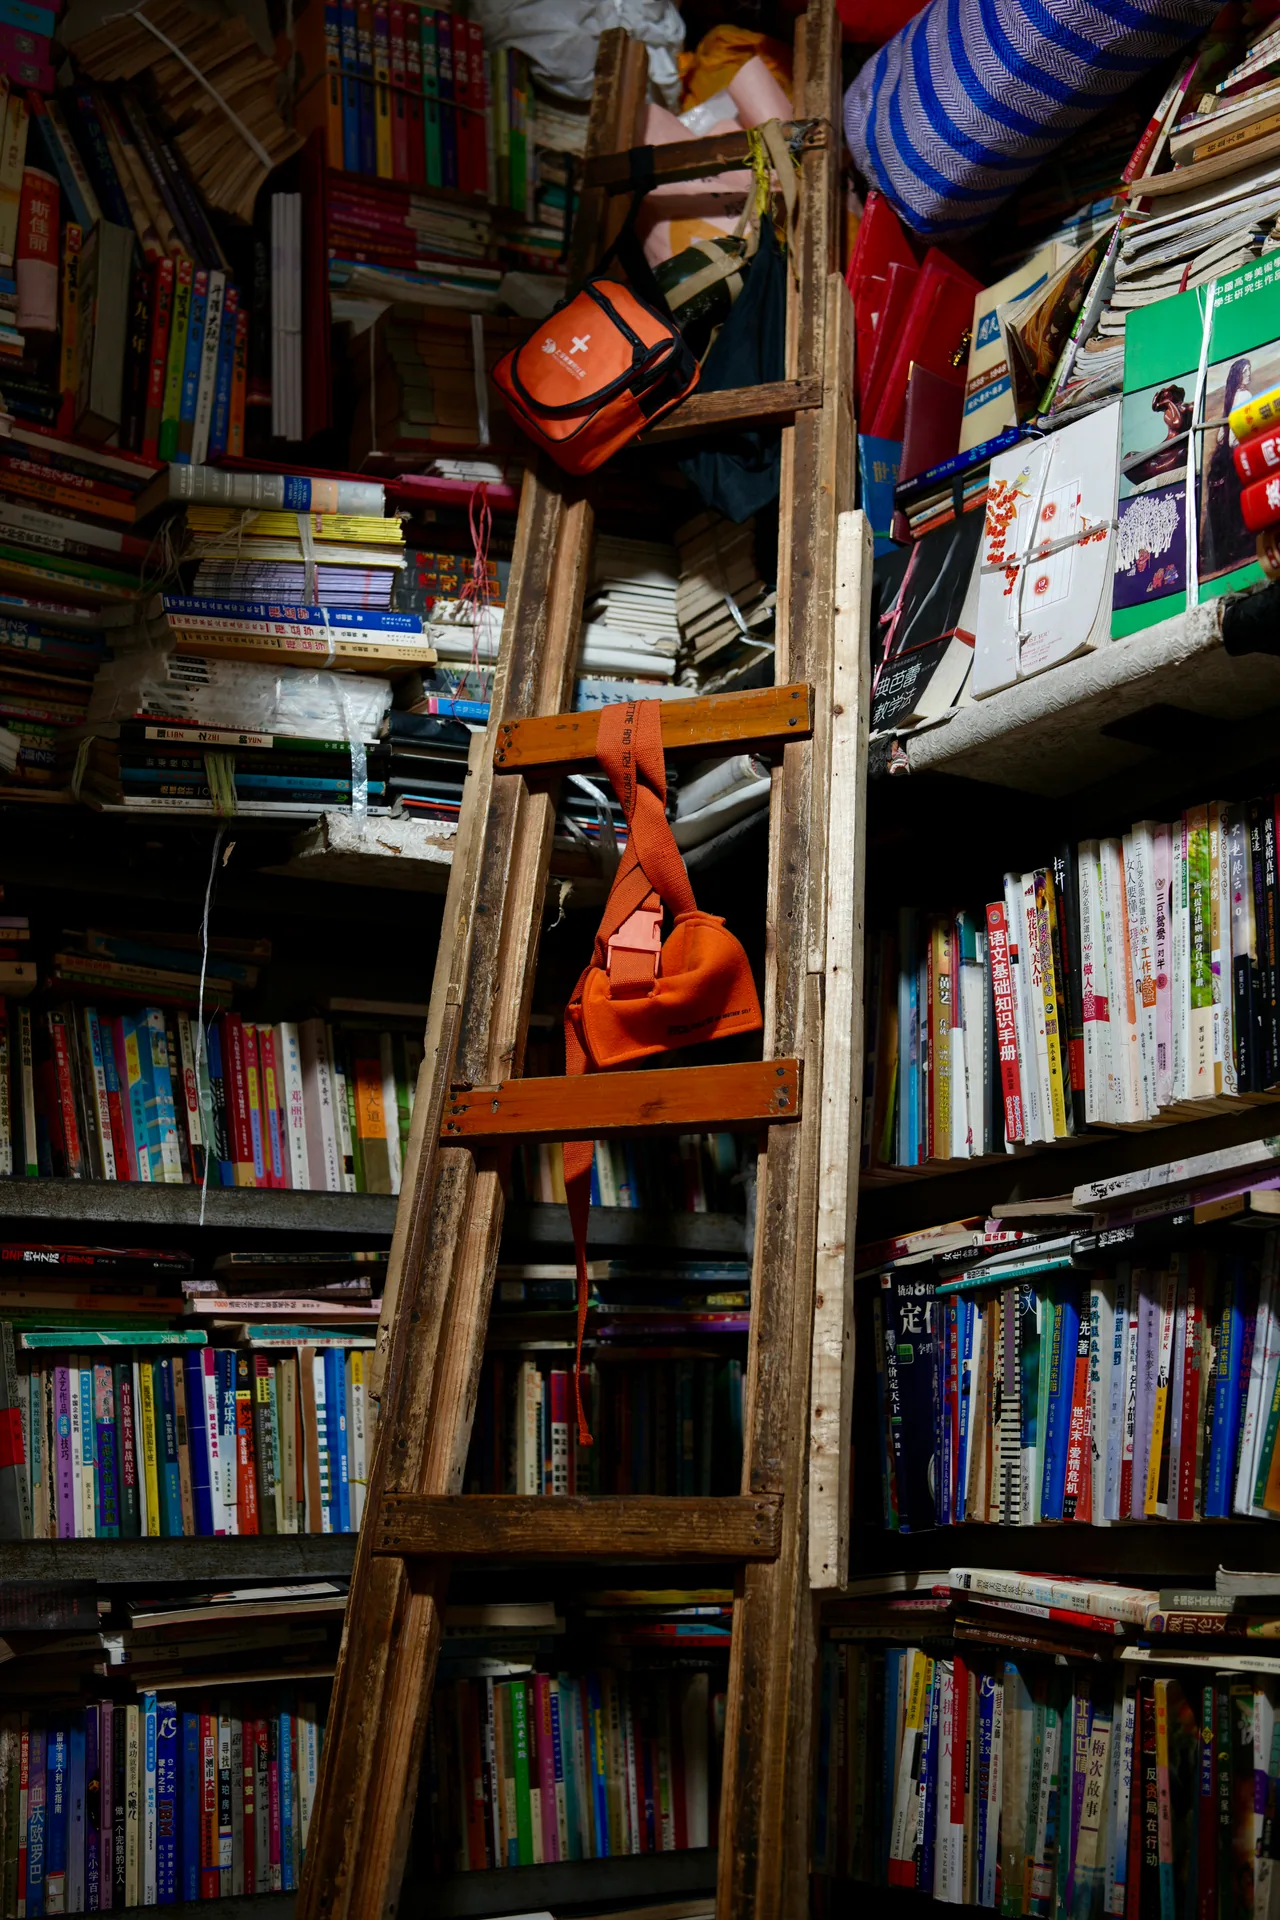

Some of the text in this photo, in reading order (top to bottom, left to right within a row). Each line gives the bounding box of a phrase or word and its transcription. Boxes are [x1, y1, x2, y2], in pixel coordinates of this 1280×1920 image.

[26, 199, 49, 254] 斯佳丽
[621, 727, 632, 746] AND
[621, 748, 632, 769] TRY
[1126, 858, 1141, 957] 女人要懂心理学
[988, 929, 1017, 1062] 语文基础知识手册
[291, 1089, 304, 1129] 邓丽君
[1077, 1339, 1090, 1355] 著
[887, 1354, 901, 1415] 定价定天下
[54, 1731, 65, 1814] 留学澳大利亚指南
[29, 1784, 46, 1884] 血沃欧罗巴
[114, 1804, 125, 1885] 做一个完整的女人
[158, 1800, 175, 1838] IBM
